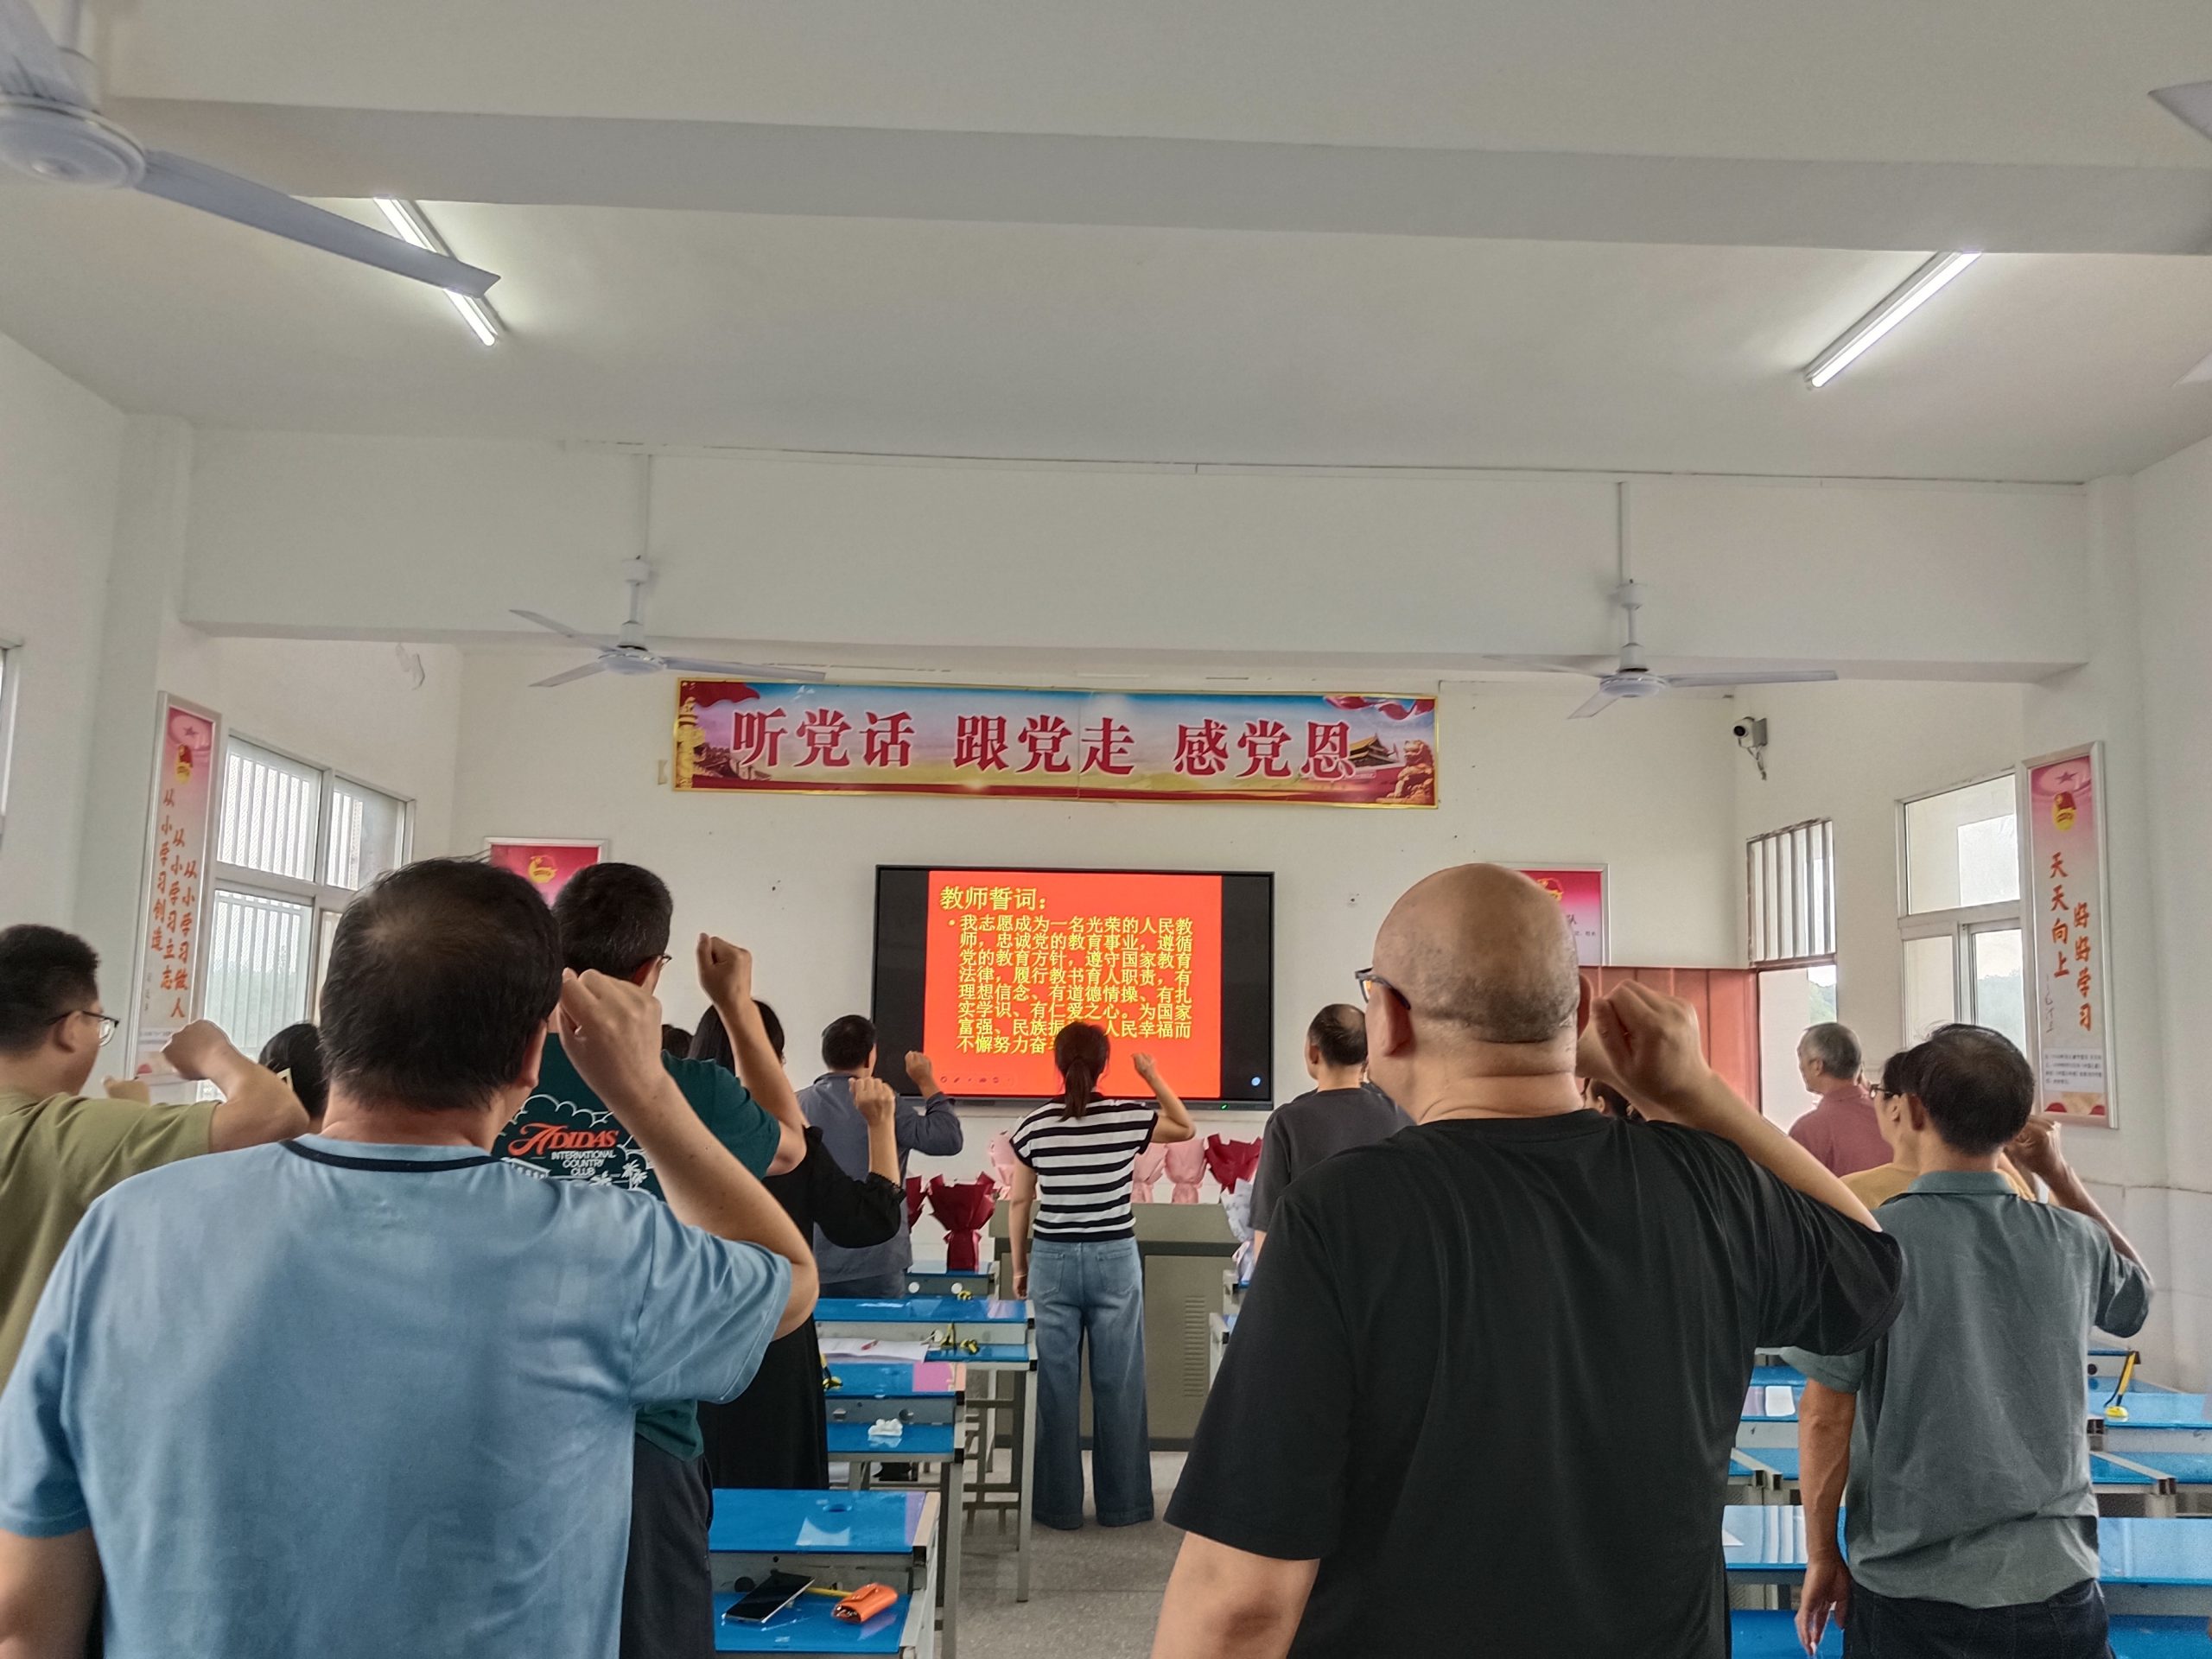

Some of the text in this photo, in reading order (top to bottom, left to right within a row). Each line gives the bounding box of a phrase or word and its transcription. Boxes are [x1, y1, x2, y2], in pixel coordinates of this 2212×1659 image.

[731, 707, 1355, 780] 听党话 跟党走 感党恩
[161, 828, 186, 990] 从小学习立志
[2050, 851, 2070, 978] 天天向上
[960, 914, 1192, 936] 我志愿成为一名光荣的人民教
[170, 860, 197, 1018] 从小学习做人
[959, 931, 1192, 952] 师，忠诚党的教育事业，遵循
[959, 950, 1192, 969] 党的教育方针，遵守国家教育
[2074, 901, 2092, 1032] 好好学习
[958, 966, 1192, 986] 法律，履行教书育人职责，有
[958, 983, 1192, 1004] 理想信念、有道德情操、有扎
[957, 1001, 1192, 1021] 实学识、有仁爱之心。为国家
[508, 1123, 620, 1157] ADIDAS
[551, 1150, 617, 1160] INTERNATIONAL
[563, 1159, 605, 1168] COUNTRY
[570, 1166, 596, 1177] CLUB
